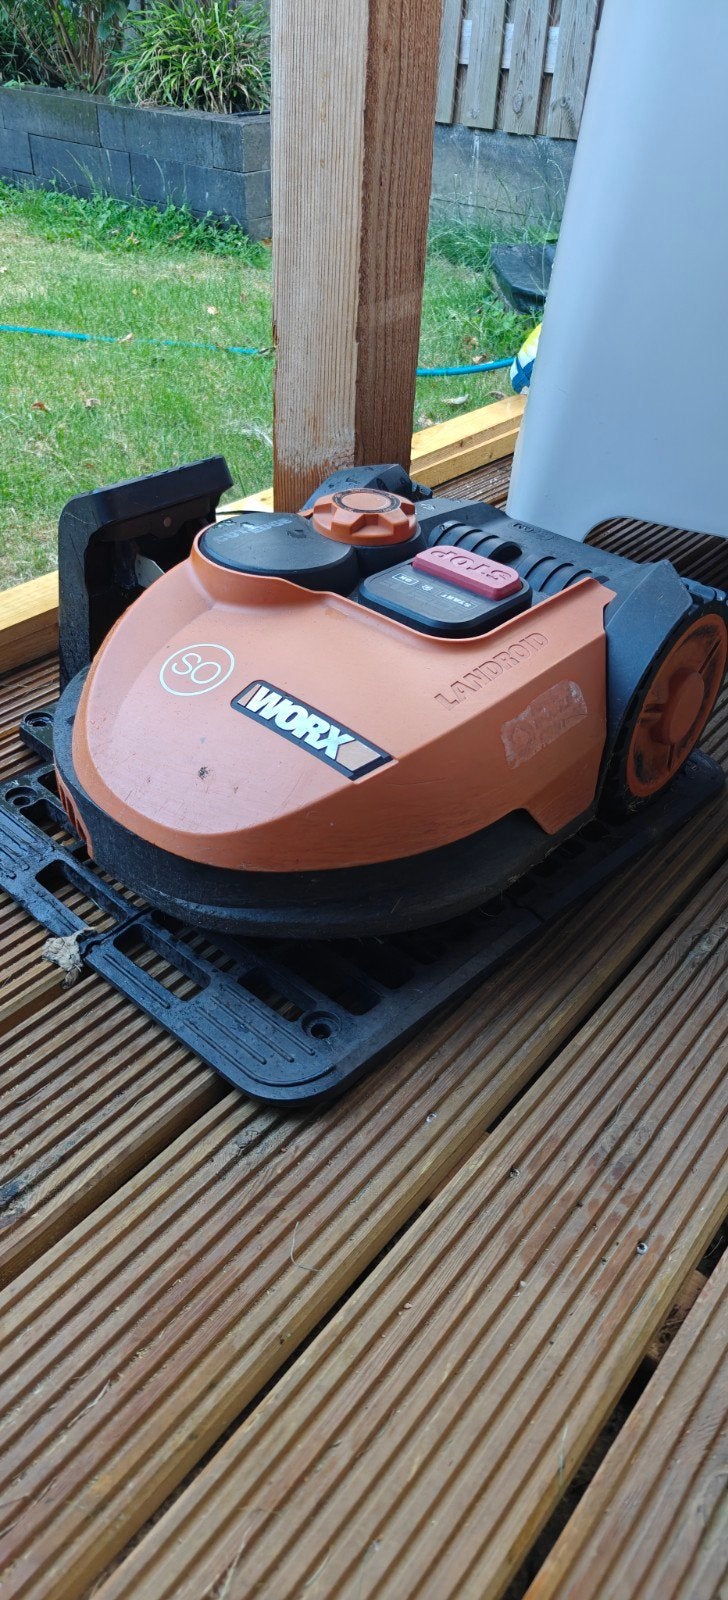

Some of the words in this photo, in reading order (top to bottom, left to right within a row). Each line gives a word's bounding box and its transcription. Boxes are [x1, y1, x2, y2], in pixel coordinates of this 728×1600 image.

[430, 550, 512, 580] STOP
[441, 593, 473, 608] START
[433, 632, 549, 711] LANDROID
[245, 685, 357, 760] WORX
